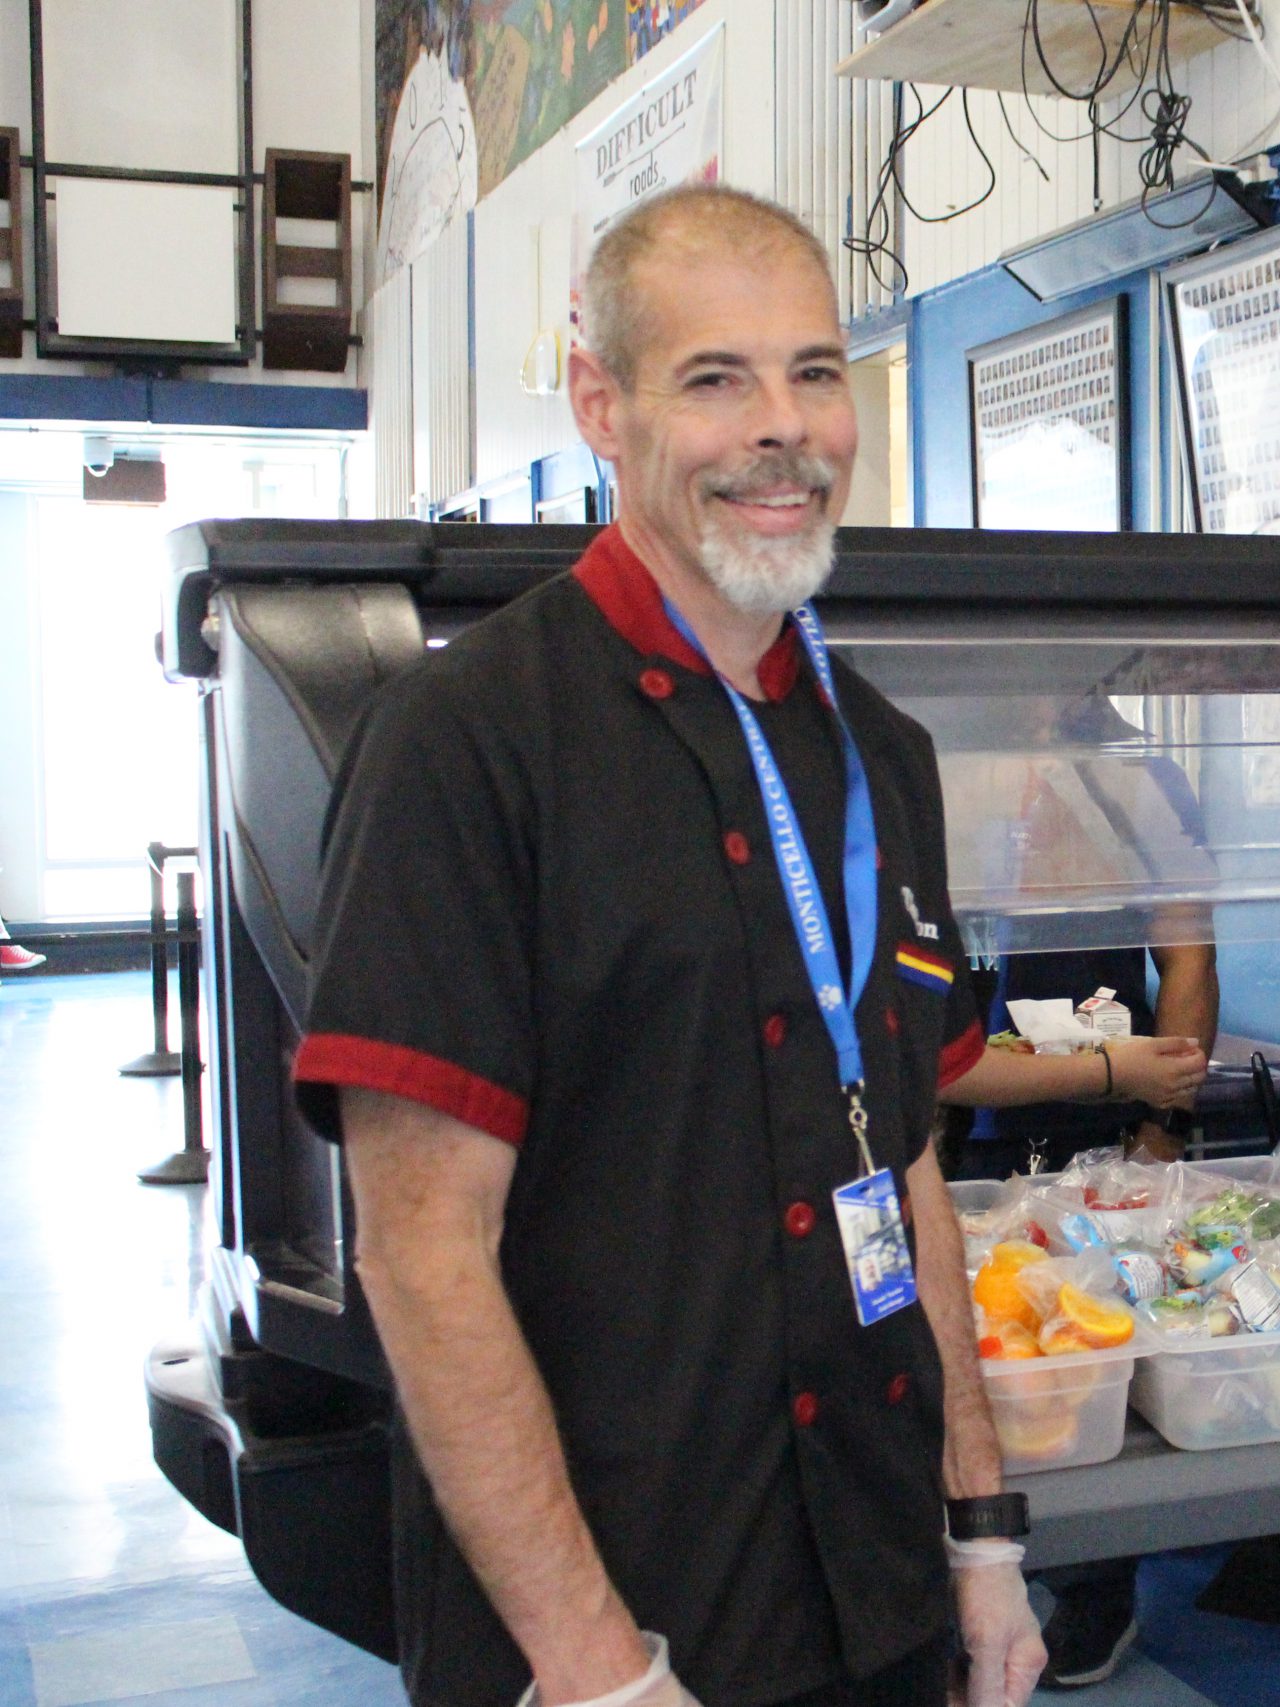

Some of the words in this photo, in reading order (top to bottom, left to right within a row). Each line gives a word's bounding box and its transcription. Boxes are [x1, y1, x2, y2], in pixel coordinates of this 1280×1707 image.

[597, 69, 697, 179] DIFFICULT
[630, 152, 659, 200] roads
[771, 803, 826, 954] MONTICELLO
